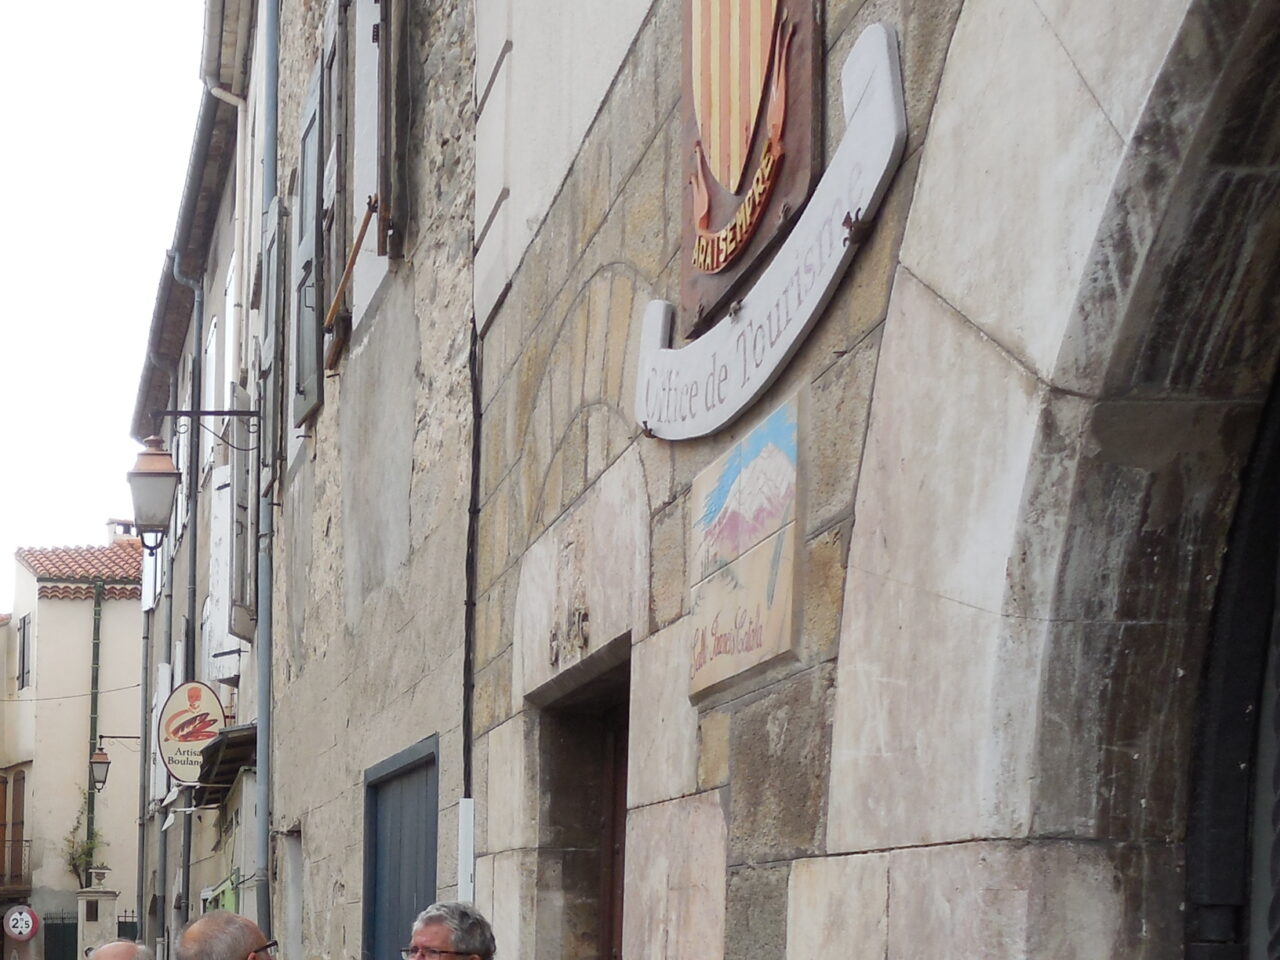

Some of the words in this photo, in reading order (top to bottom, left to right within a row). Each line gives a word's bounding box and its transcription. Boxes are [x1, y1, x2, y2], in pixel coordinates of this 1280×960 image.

[644, 366, 699, 423] Office
[704, 352, 728, 412] de
[174, 747, 203, 757] Artisa
[167, 756, 202, 766] Boulan
